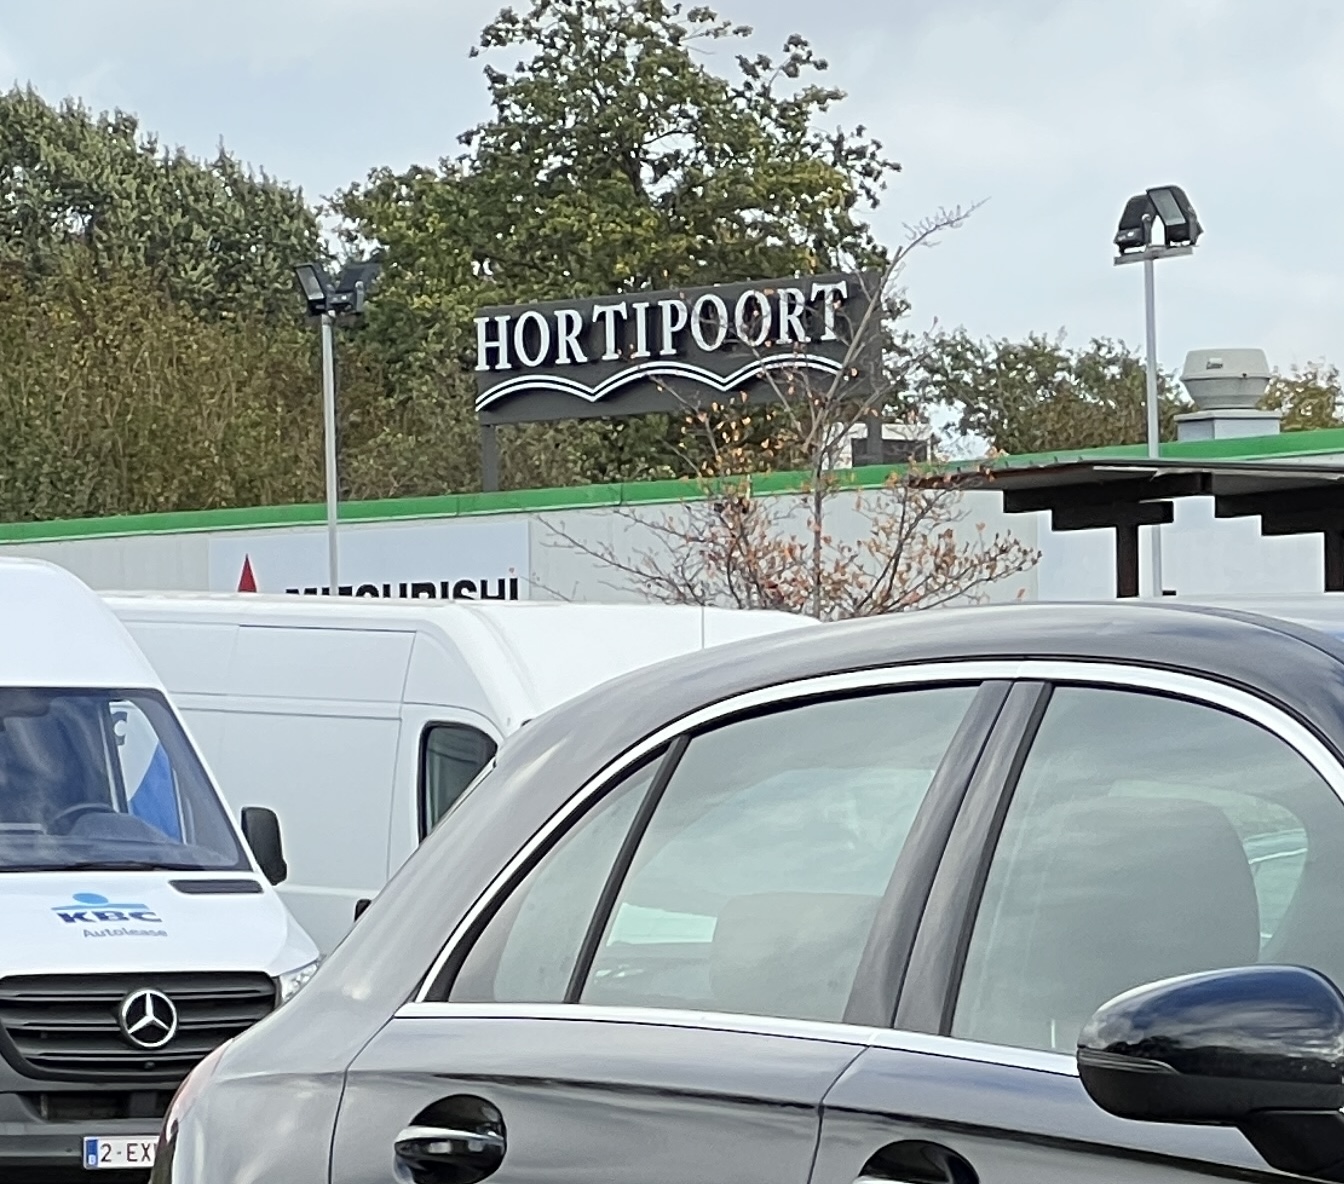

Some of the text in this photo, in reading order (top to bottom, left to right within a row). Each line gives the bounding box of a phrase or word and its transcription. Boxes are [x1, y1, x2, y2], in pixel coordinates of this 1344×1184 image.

[474, 281, 847, 371] HORTIPOORT
[56, 911, 162, 923] KBC
[83, 927, 168, 938] Autolease
[100, 1142, 156, 1163] 2-EX
